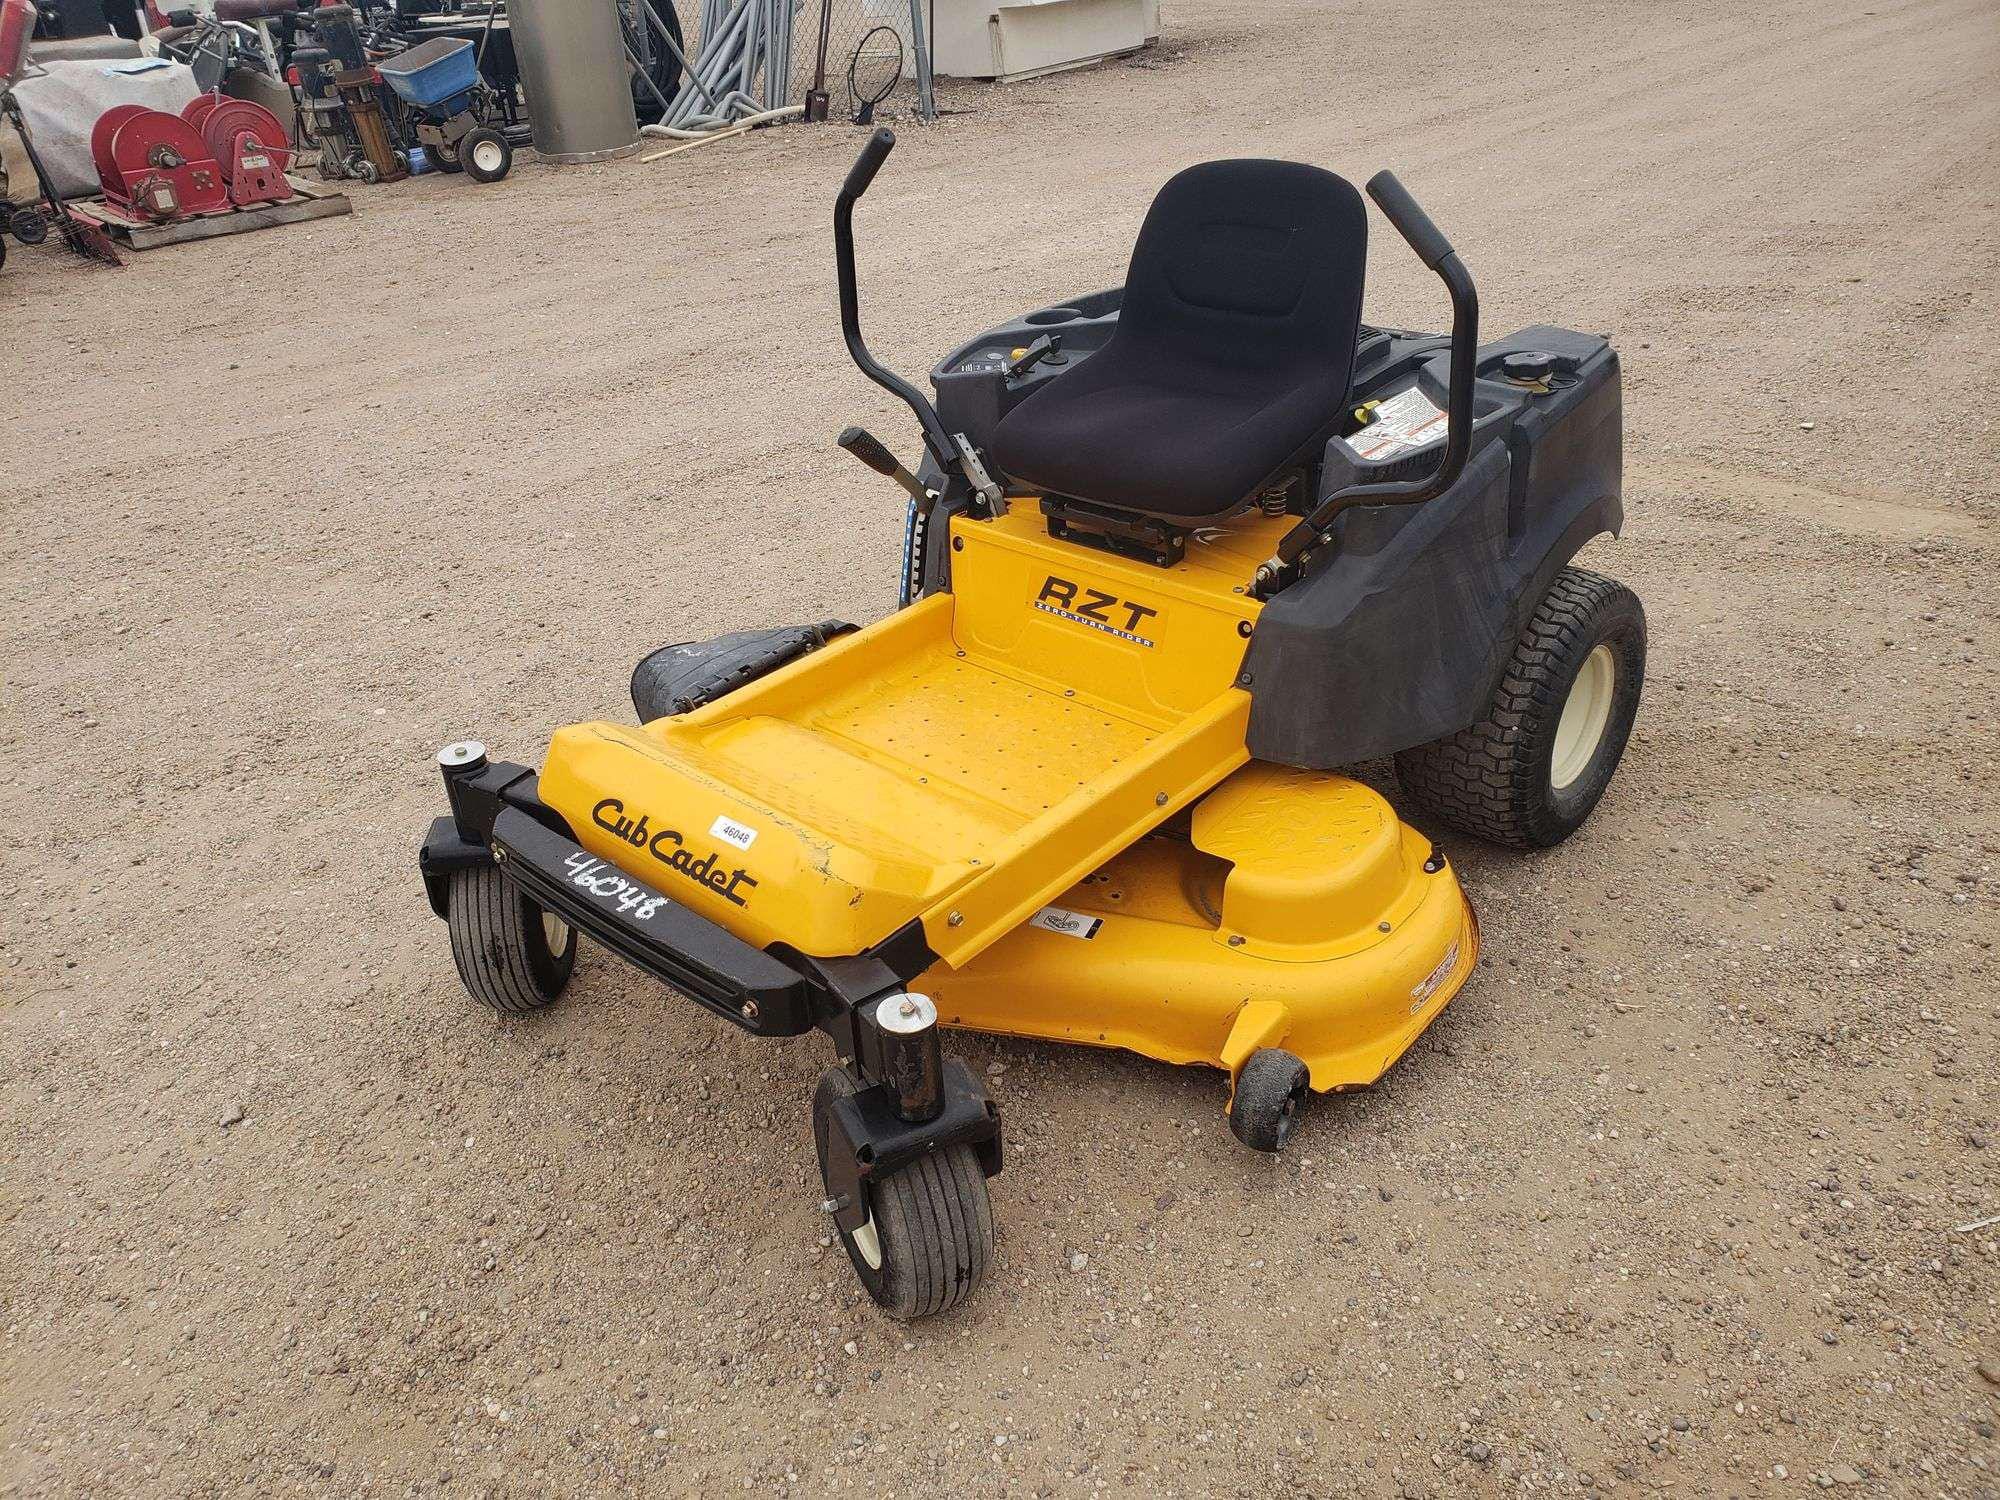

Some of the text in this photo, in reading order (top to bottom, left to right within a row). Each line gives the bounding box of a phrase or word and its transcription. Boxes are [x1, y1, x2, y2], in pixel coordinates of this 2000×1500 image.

[1038, 575, 1158, 632] RZT
[1112, 629, 1151, 647] RIDER
[592, 798, 759, 907] Cub Cadet
[723, 825, 750, 844] 46048
[564, 850, 669, 921] 46048
